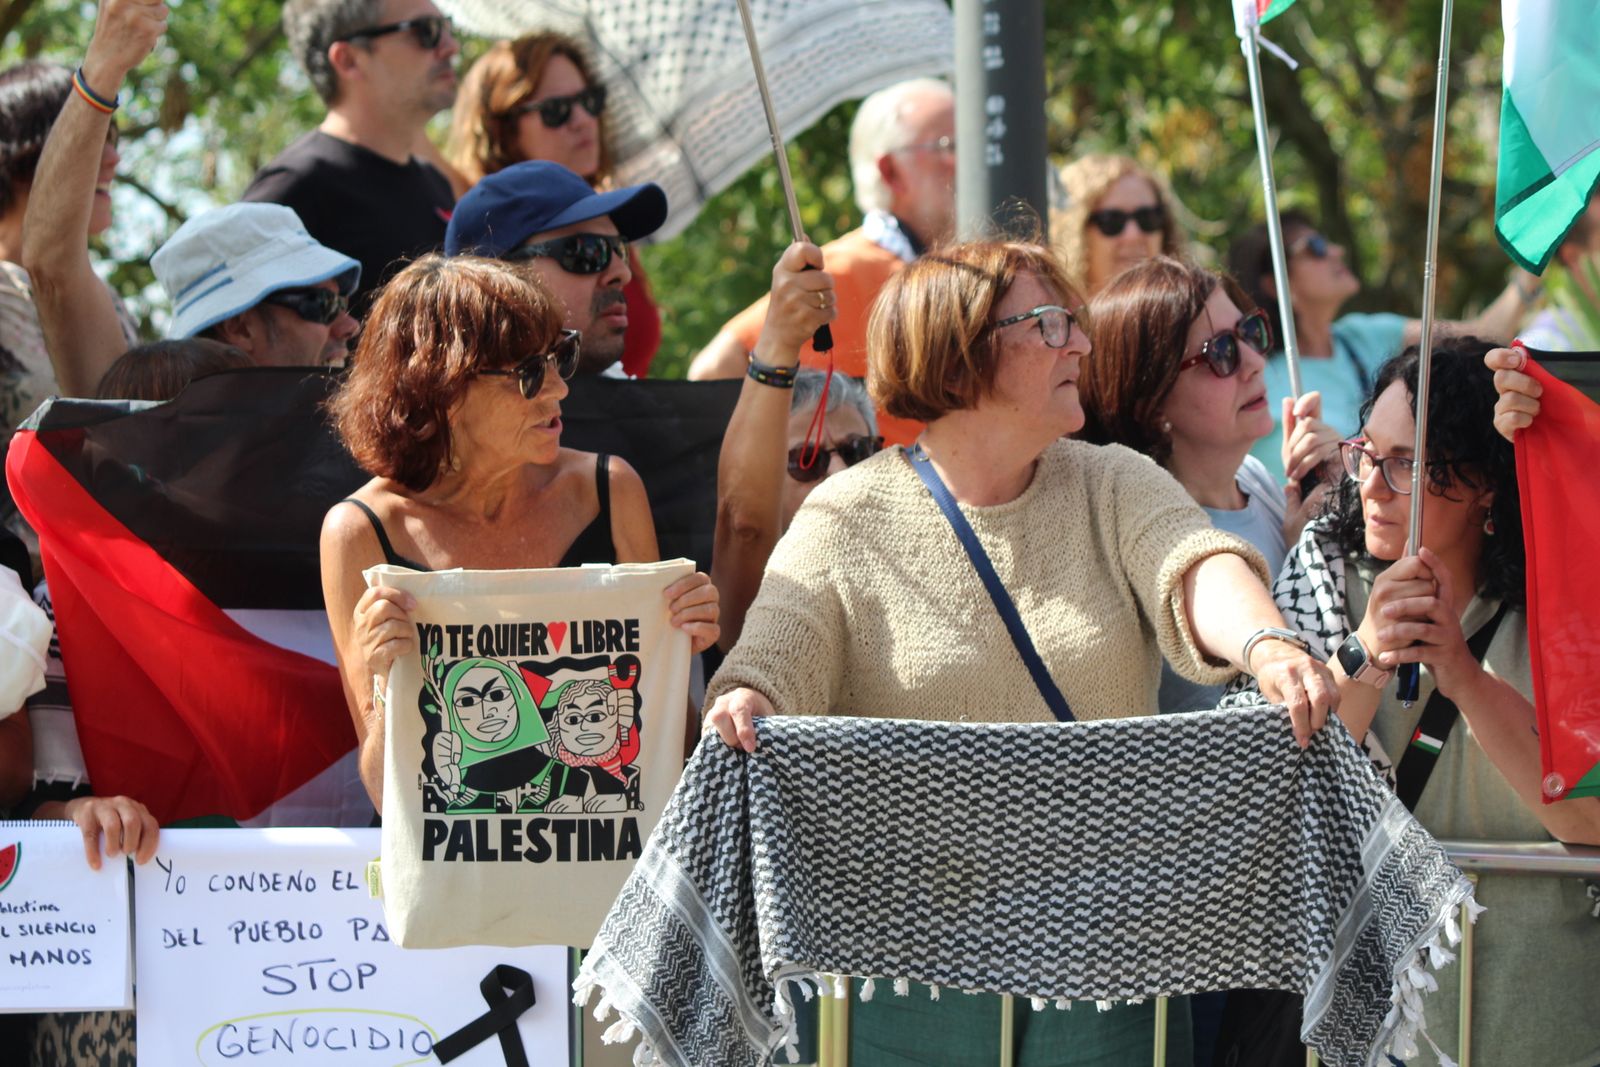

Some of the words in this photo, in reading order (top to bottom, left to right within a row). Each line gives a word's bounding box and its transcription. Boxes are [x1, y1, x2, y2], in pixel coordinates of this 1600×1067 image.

[416, 622, 443, 656] YO
[446, 624, 474, 657] TE
[570, 618, 640, 654] LIBRE
[422, 817, 643, 864] PALESTINA
[208, 869, 317, 893] CONDENO
[332, 870, 360, 891] EL
[0, 900, 60, 914] alestina
[0, 925, 10, 938] L
[18, 921, 96, 937] SILENCIO
[162, 927, 205, 948] DEL
[228, 919, 323, 944] PUEBLO
[347, 917, 390, 942] PA
[9, 947, 92, 968] MANOS
[262, 958, 377, 995] STOP
[216, 1018, 433, 1058] GENOCIDIO
